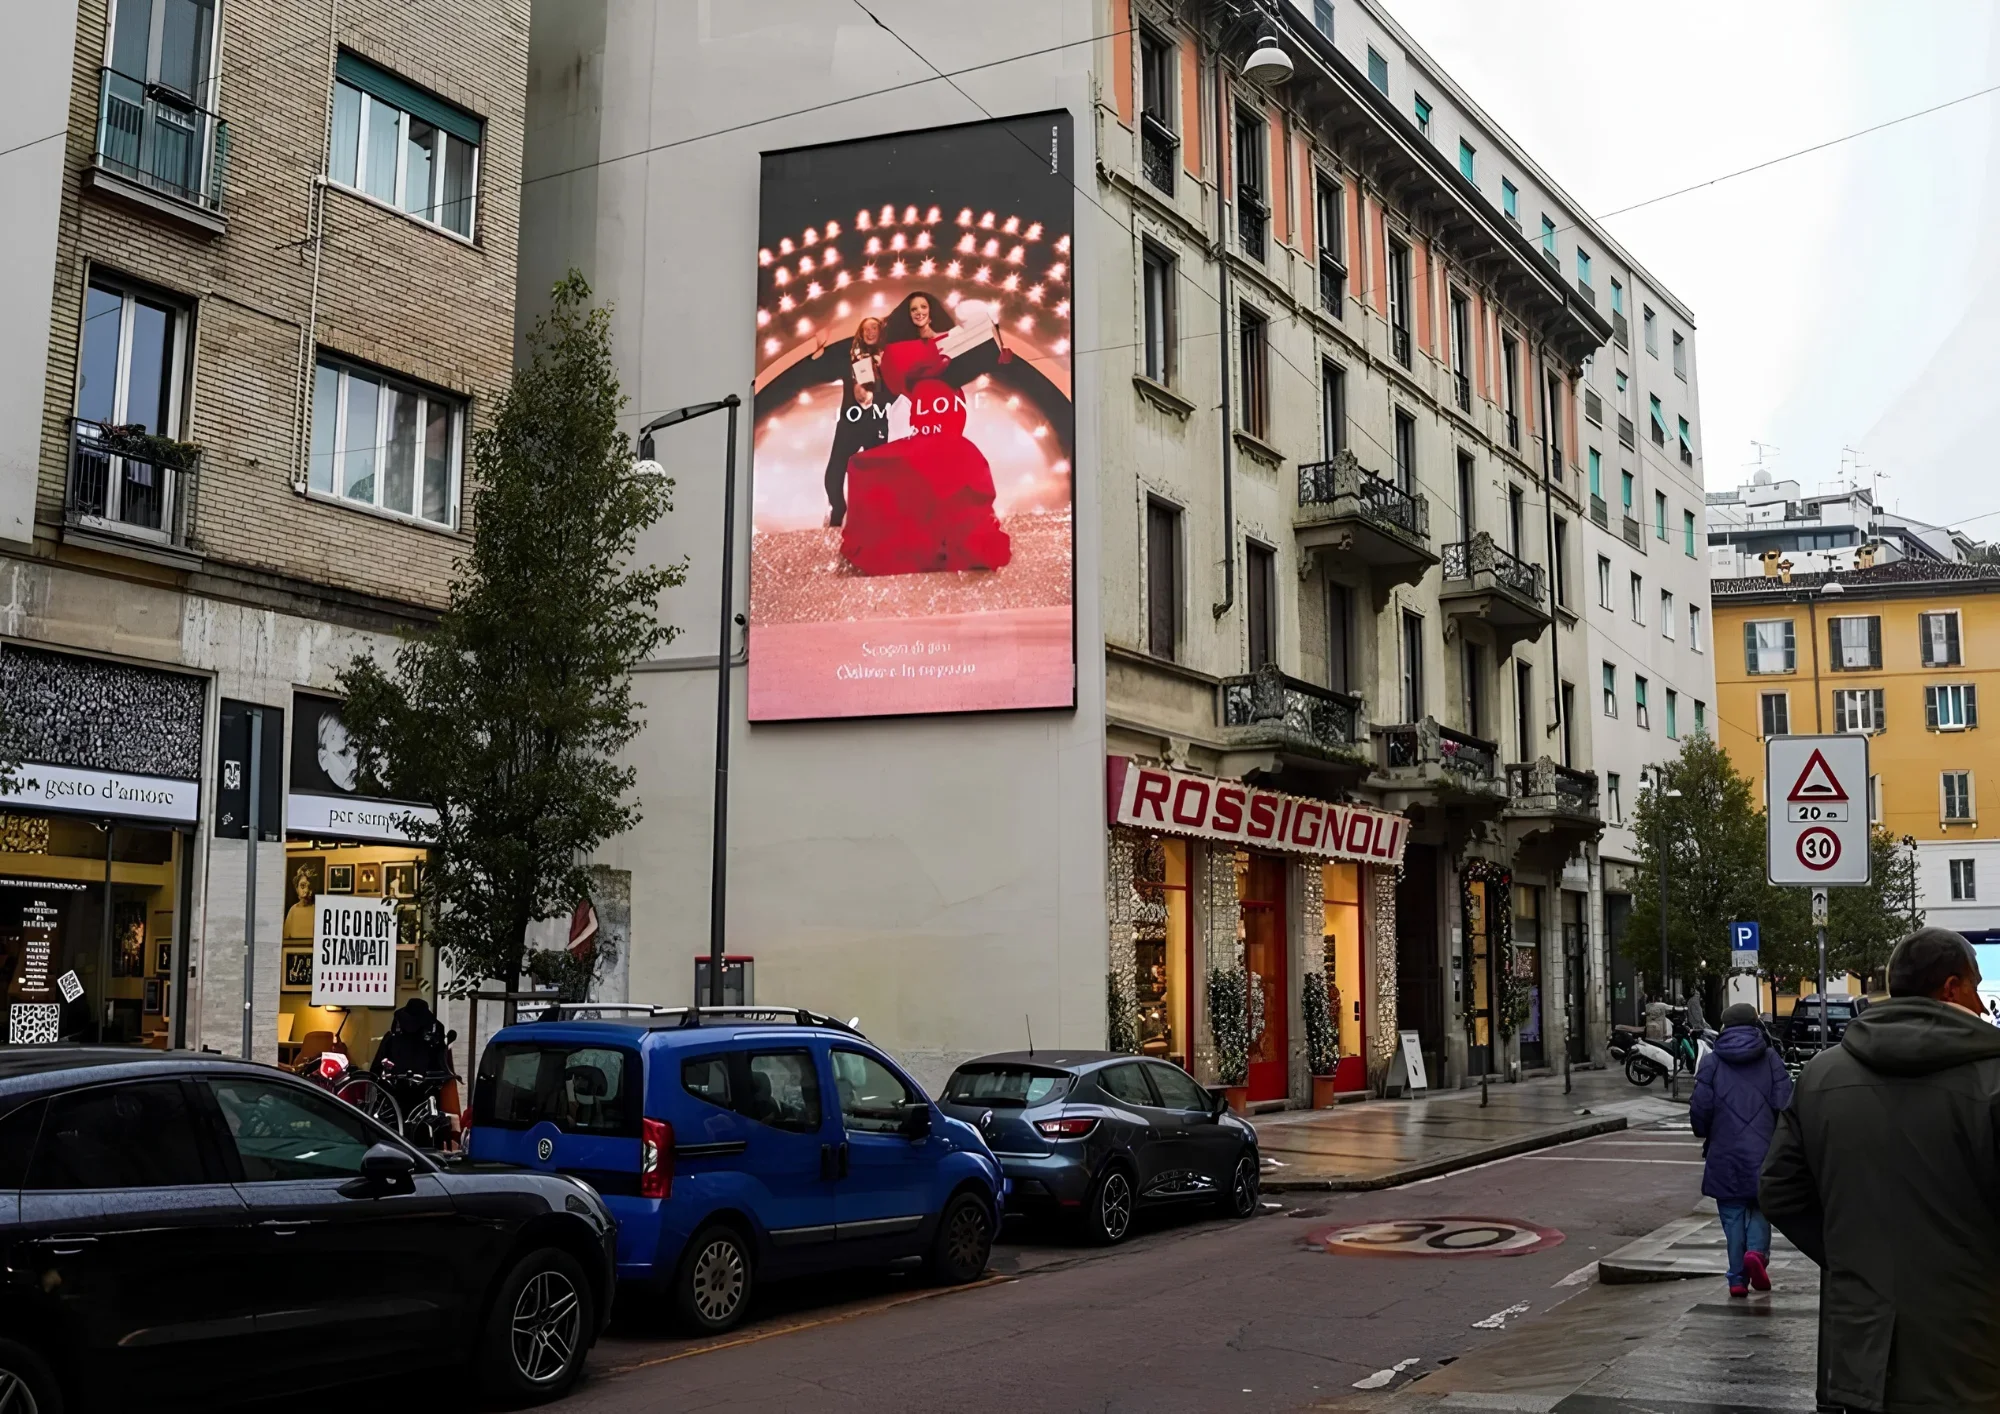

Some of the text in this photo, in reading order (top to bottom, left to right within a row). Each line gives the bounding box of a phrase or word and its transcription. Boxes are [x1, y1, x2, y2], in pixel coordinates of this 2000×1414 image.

[45, 779, 95, 799] gesto
[102, 779, 174, 805] d'amore
[1132, 770, 1399, 858] ROSSIGNOLI
[1799, 807, 1821, 820] 20
[1806, 838, 1831, 858] 30
[323, 909, 389, 938] RICORDI
[1738, 927, 1752, 947] P
[321, 938, 389, 966] STAMPATI
